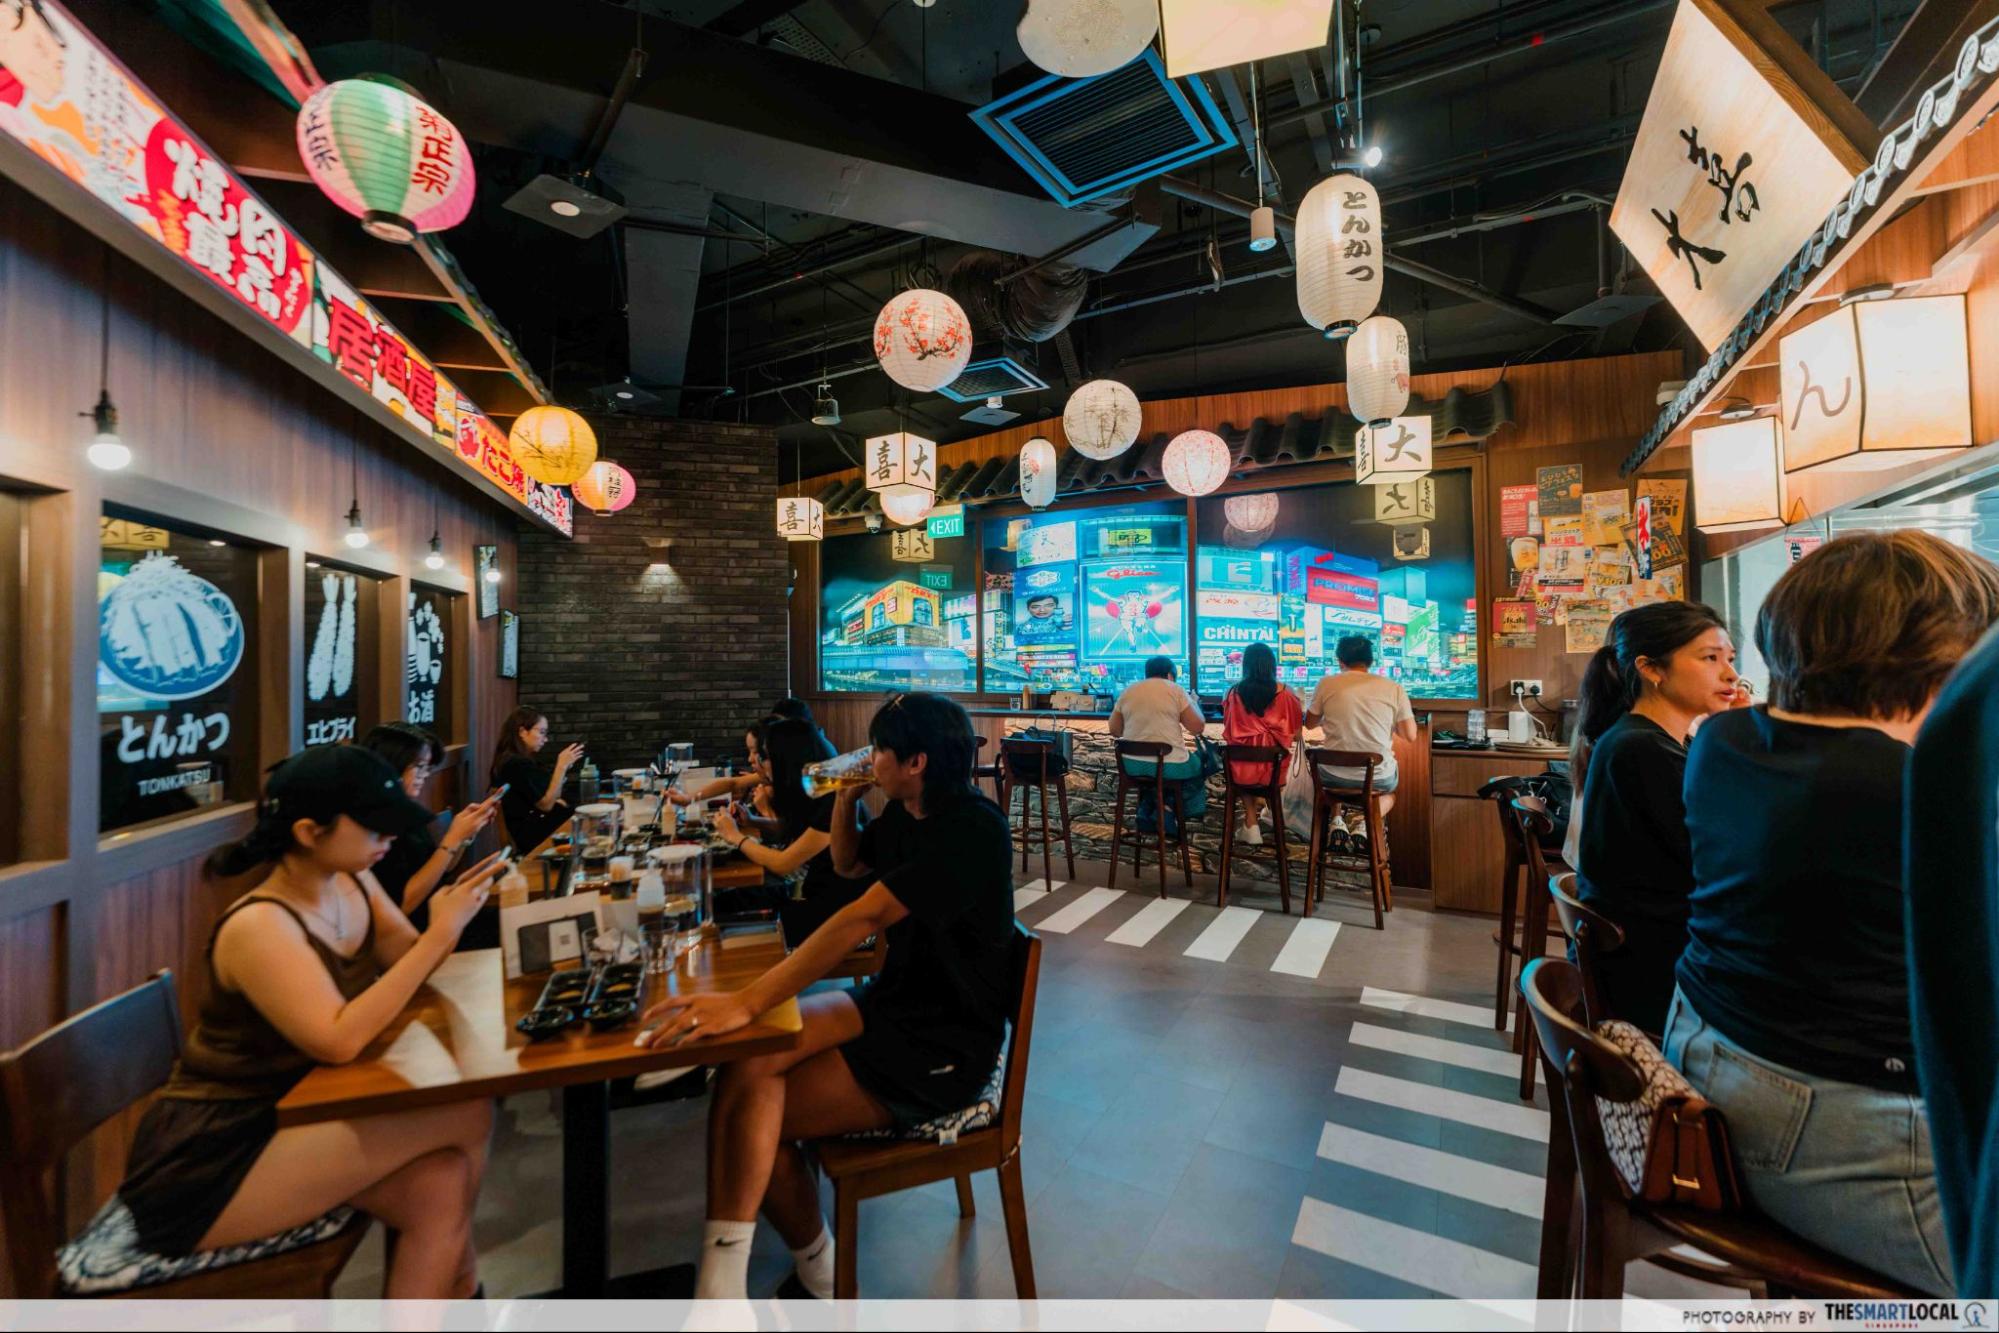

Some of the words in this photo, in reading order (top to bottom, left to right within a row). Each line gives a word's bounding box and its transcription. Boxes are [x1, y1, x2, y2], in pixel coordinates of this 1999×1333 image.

[1341, 191, 1376, 282] とんかつ
[329, 294, 437, 424] 居酒屋
[870, 440, 898, 481] 喜
[1384, 424, 1422, 462] 大
[911, 444, 931, 482] 大
[780, 501, 805, 530] 喜
[936, 518, 961, 535] EXIT
[117, 712, 230, 763] とんかつ
[137, 768, 211, 796] TONKATSU
